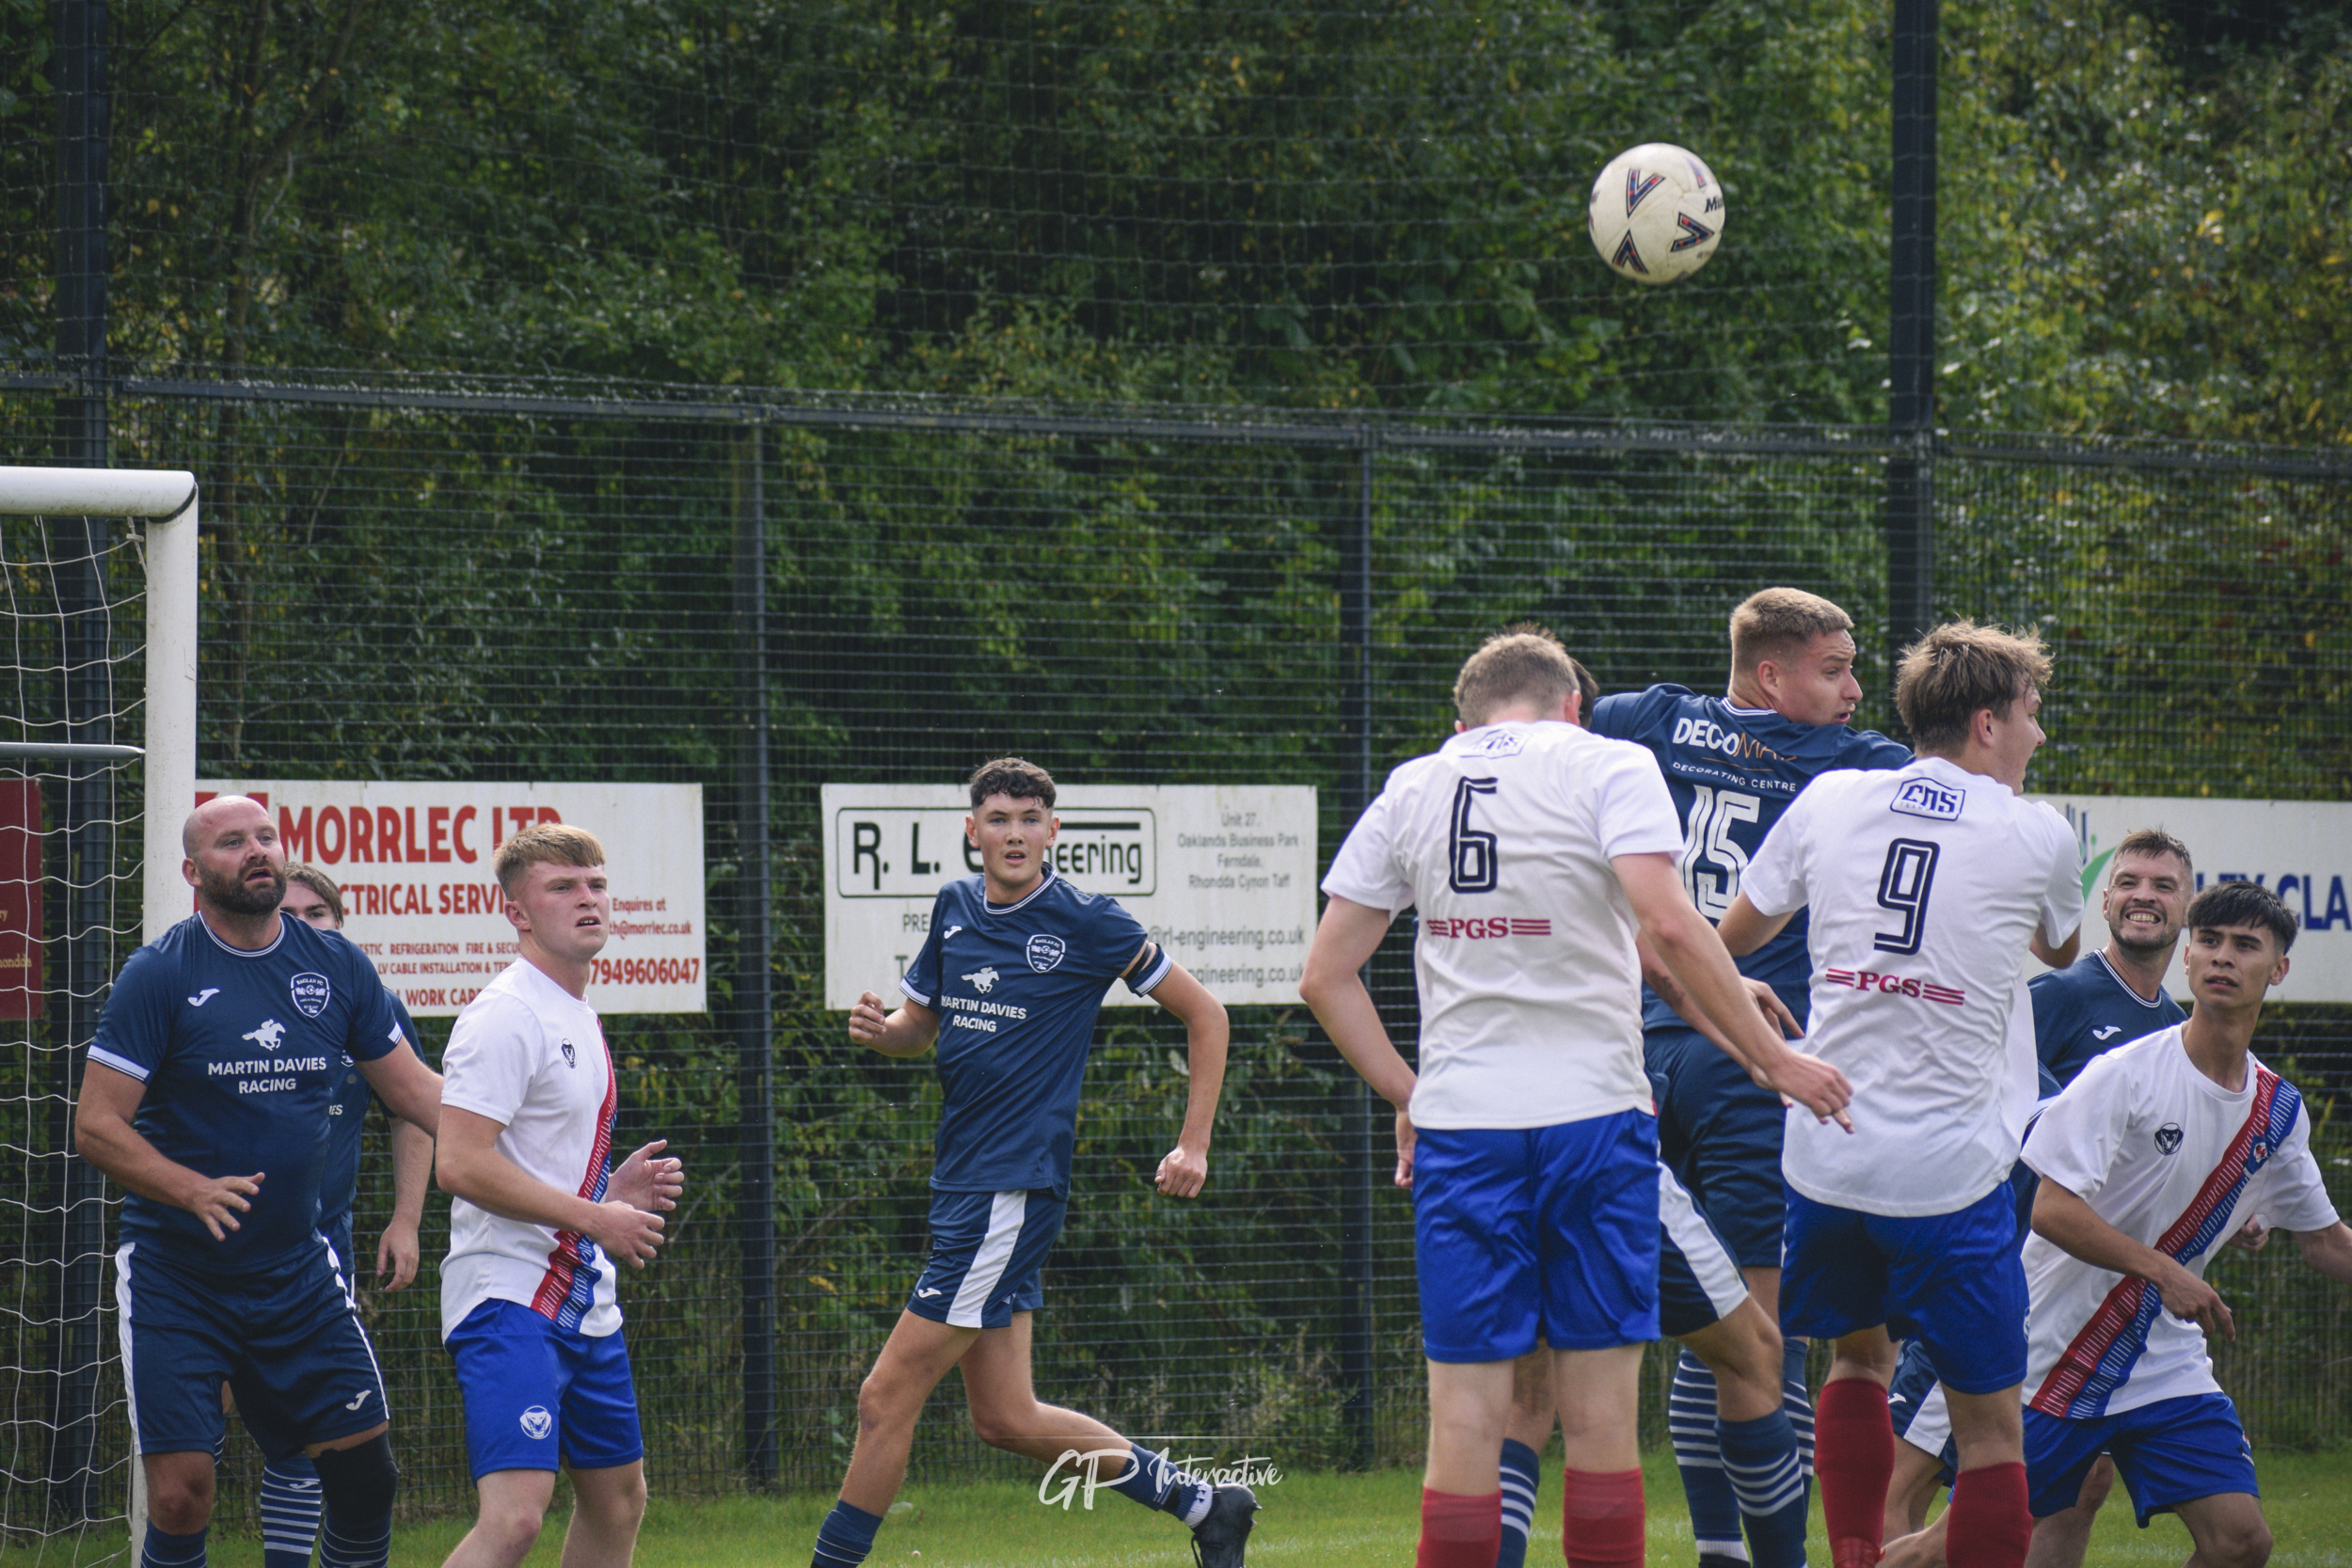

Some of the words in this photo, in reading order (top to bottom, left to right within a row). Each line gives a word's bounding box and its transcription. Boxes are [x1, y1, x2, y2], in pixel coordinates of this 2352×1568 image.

[1673, 762, 1746, 786] DECORATING
[1751, 779, 1797, 792] CENTRE
[1222, 813, 1242, 826] Unit
[279, 805, 478, 864] MORRLEC
[1178, 833, 1226, 847] Oaklands
[1230, 833, 1274, 847] Business
[1278, 833, 1298, 847] Park
[1449, 776, 1499, 894] 6
[853, 821, 889, 891] R.
[911, 821, 941, 874] L.
[1677, 784, 1760, 921] 15
[1188, 874, 1235, 889] Rhondda
[1238, 874, 1268, 891] Cynon
[1273, 873, 1291, 888] Taff
[438, 882, 504, 914] SERVI
[613, 896, 653, 913] Enquires
[657, 897, 666, 911] at
[1873, 837, 1941, 956] 9
[610, 919, 691, 940] th@morrlec.co.uk
[1148, 926, 1305, 951] @rl-engineering.co.uk
[1448, 917, 1509, 940] PGS
[390, 942, 458, 955] REFRIGERATION
[467, 942, 484, 954] FIRE
[487, 942, 493, 954] &
[378, 962, 388, 974] LV
[390, 962, 417, 974] CABLE
[421, 961, 482, 974] INSTALLATION
[485, 961, 491, 973] &
[586, 958, 699, 985] 7949606047
[1855, 971, 1922, 998] PGS
[405, 989, 446, 1006] WORK
[941, 995, 979, 1012] MARTIN
[980, 1002, 1027, 1020] DAVIES
[952, 1015, 997, 1033] RACING
[208, 1059, 270, 1076] MARTIN
[274, 1056, 327, 1072] DAVIES
[239, 1078, 296, 1094] RACING
